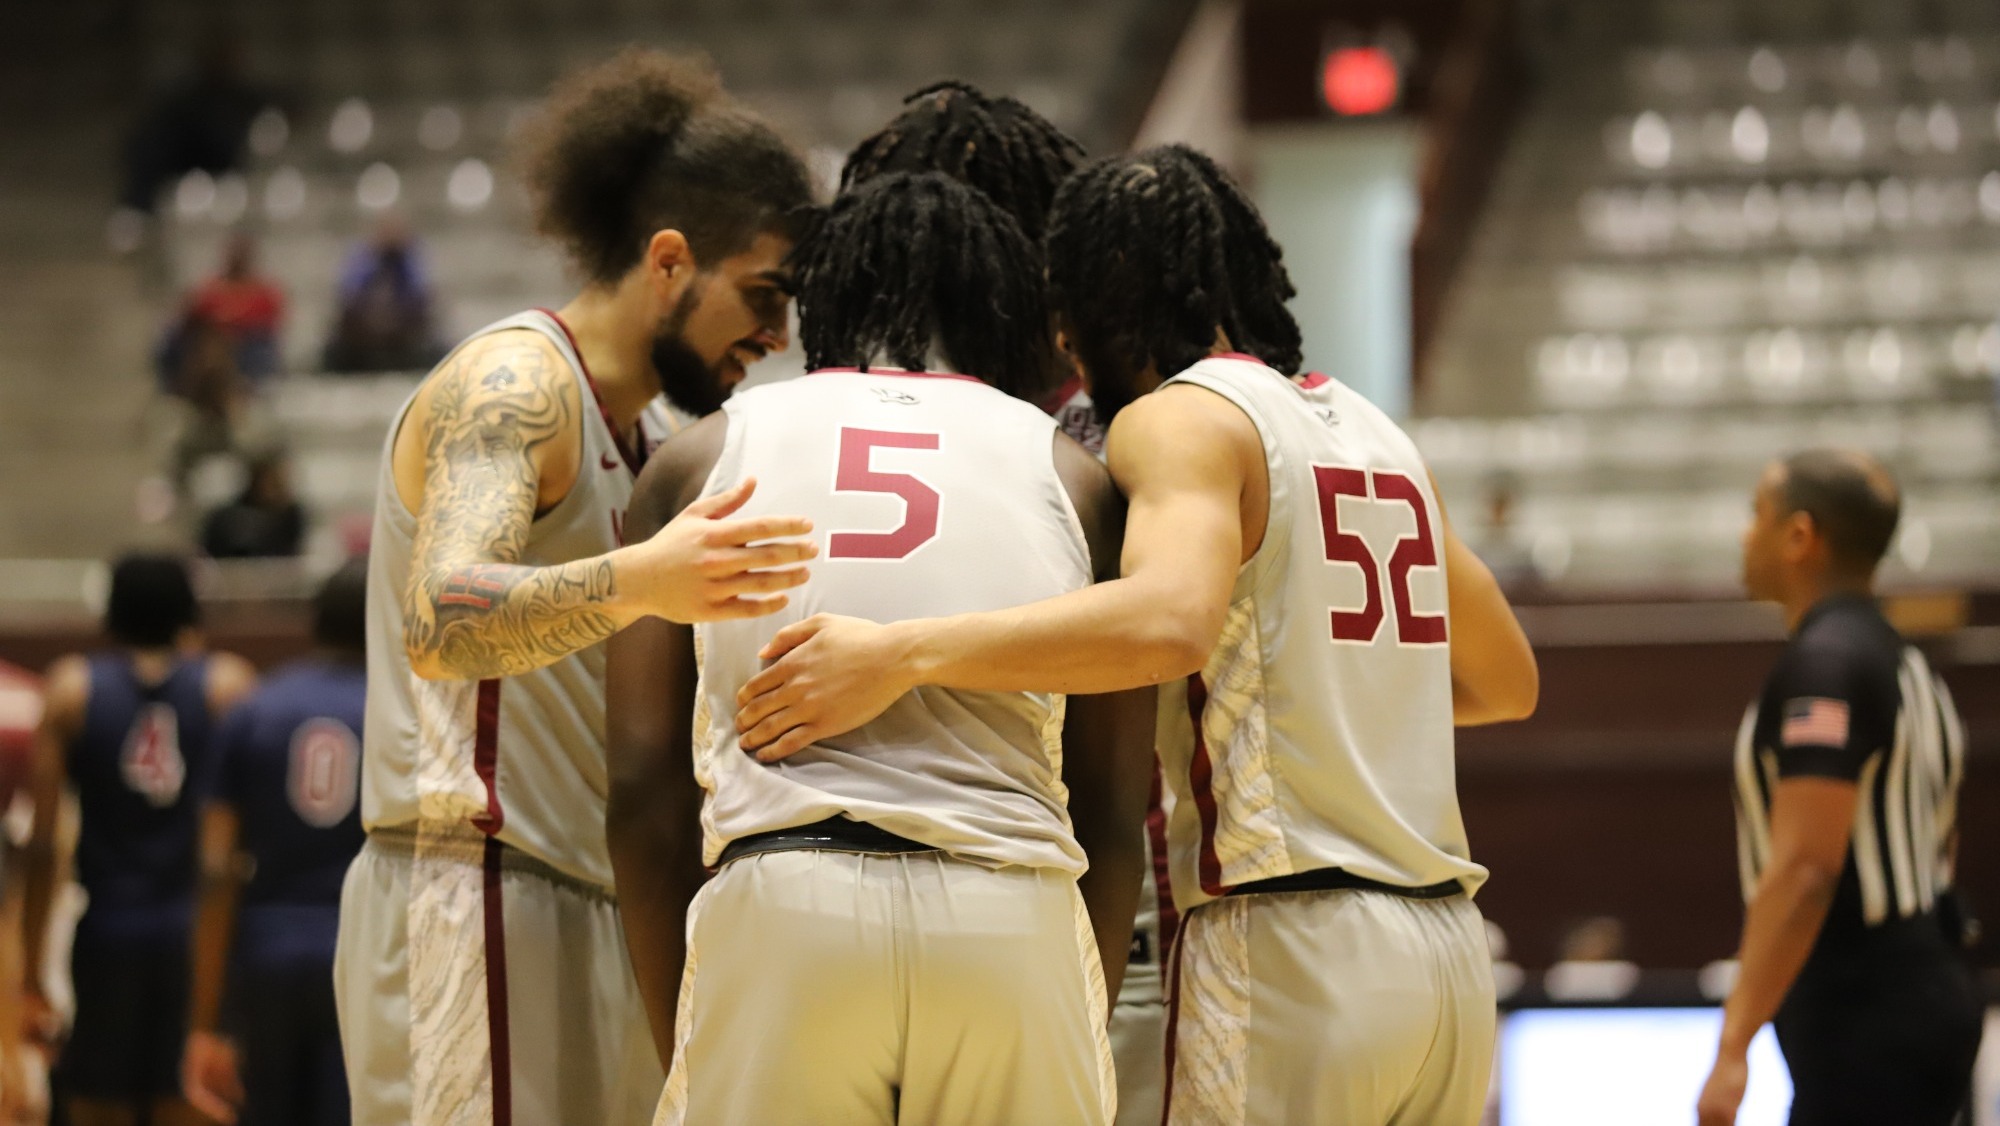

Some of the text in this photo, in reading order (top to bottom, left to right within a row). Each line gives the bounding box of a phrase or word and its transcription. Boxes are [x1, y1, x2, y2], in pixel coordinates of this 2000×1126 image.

[826, 424, 943, 562] 5
[1310, 461, 1448, 647] 52
[120, 702, 187, 807] 4
[287, 717, 361, 828] 0
